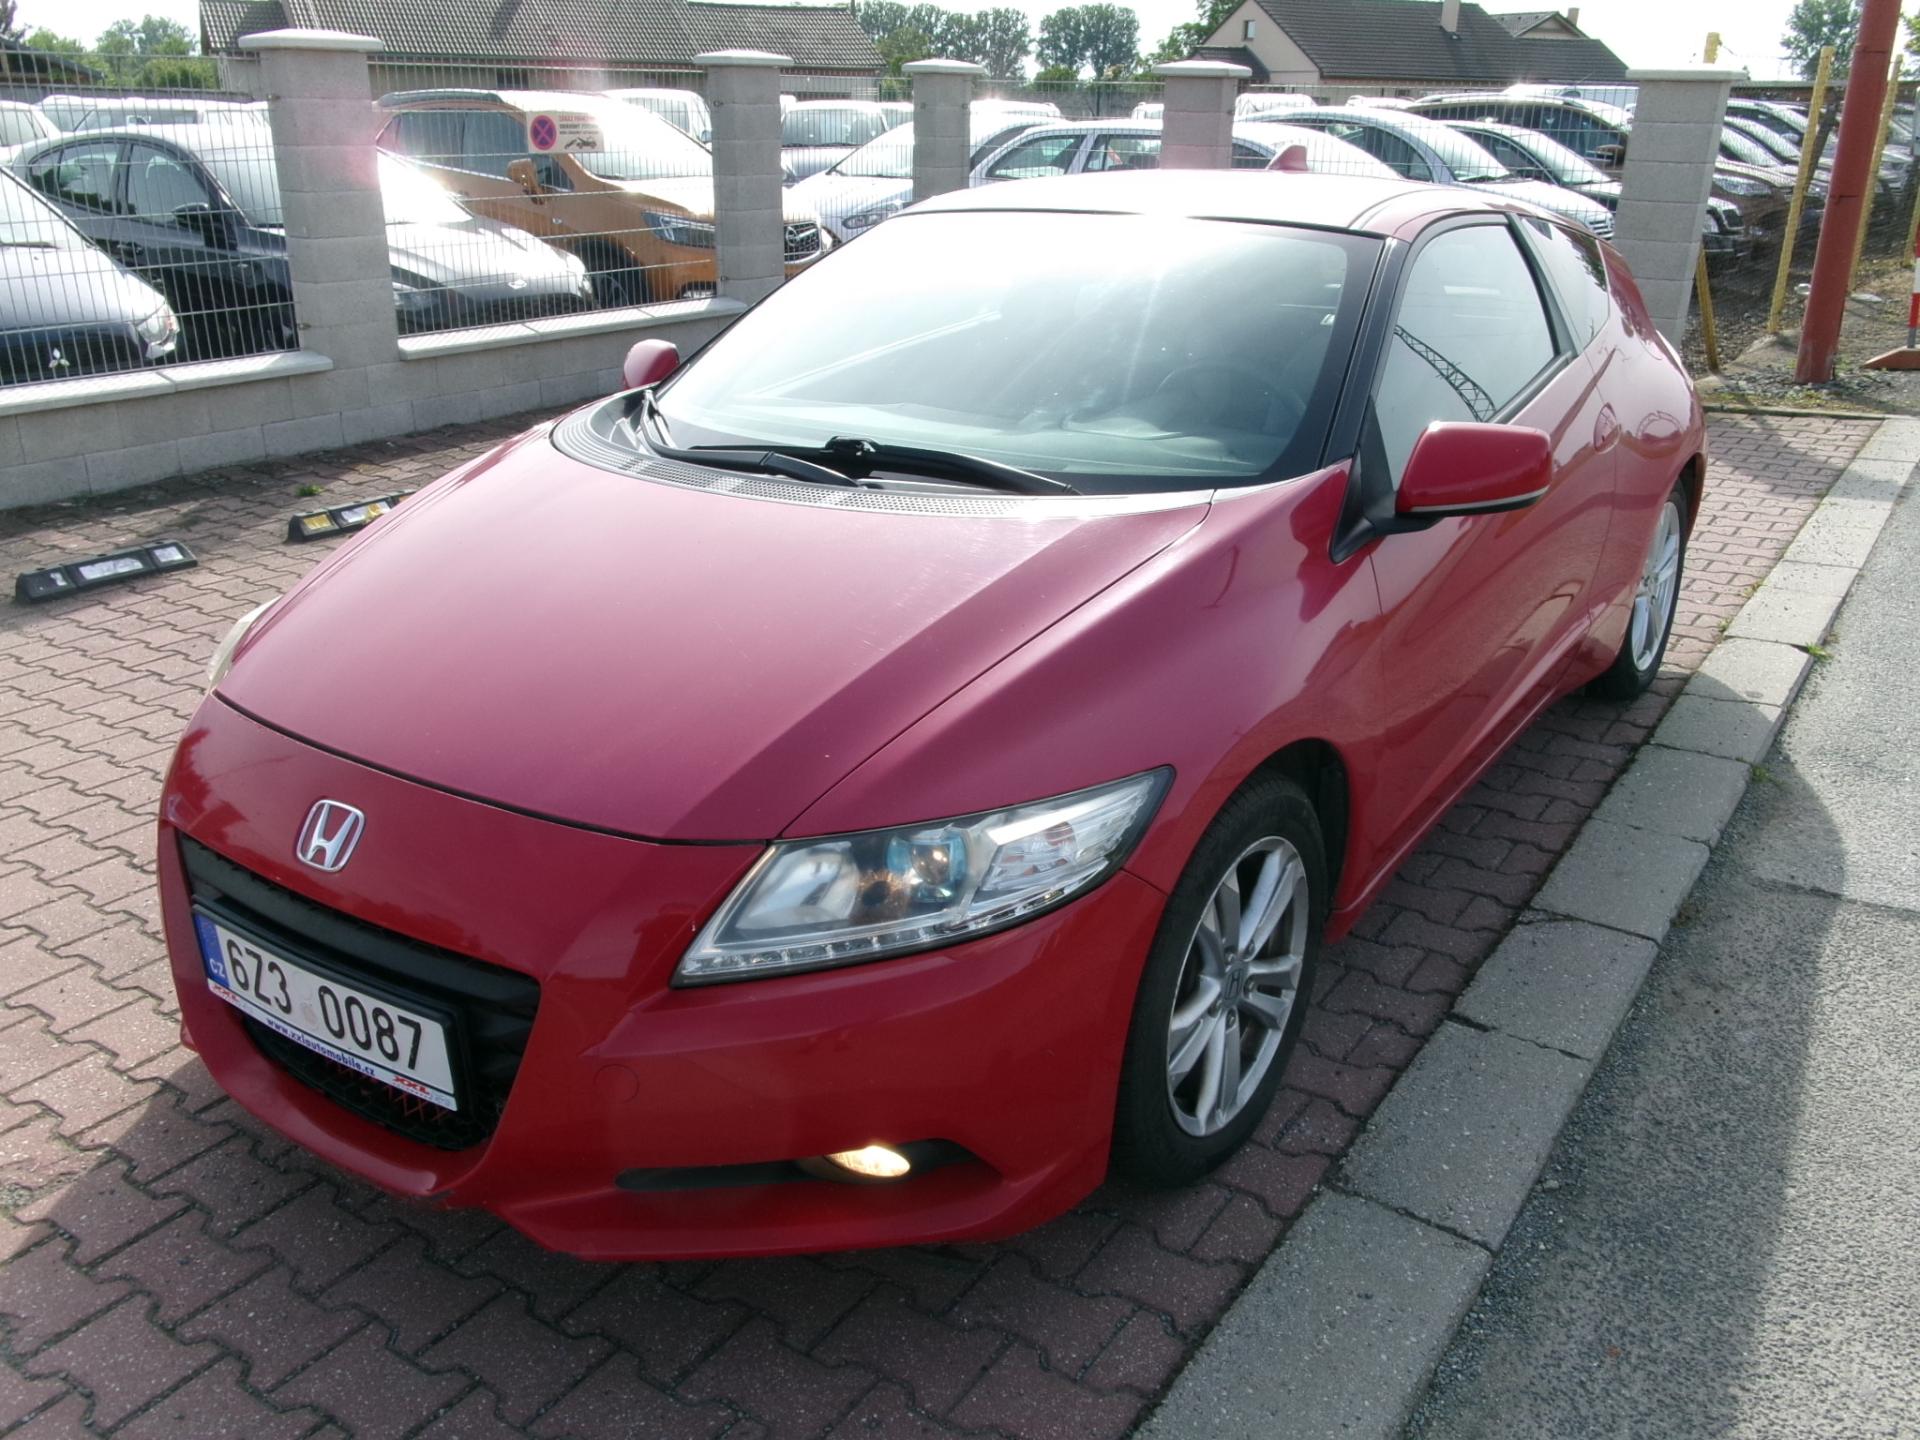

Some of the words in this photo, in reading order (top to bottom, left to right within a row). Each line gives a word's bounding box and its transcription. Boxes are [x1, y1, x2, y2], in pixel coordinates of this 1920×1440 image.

[209, 957, 225, 978] CZ
[226, 938, 292, 1015] 6Z3
[317, 985, 422, 1071] 0087
[266, 1017, 376, 1077] www.xxlautomobile.cz
[392, 1074, 431, 1096] XXL
